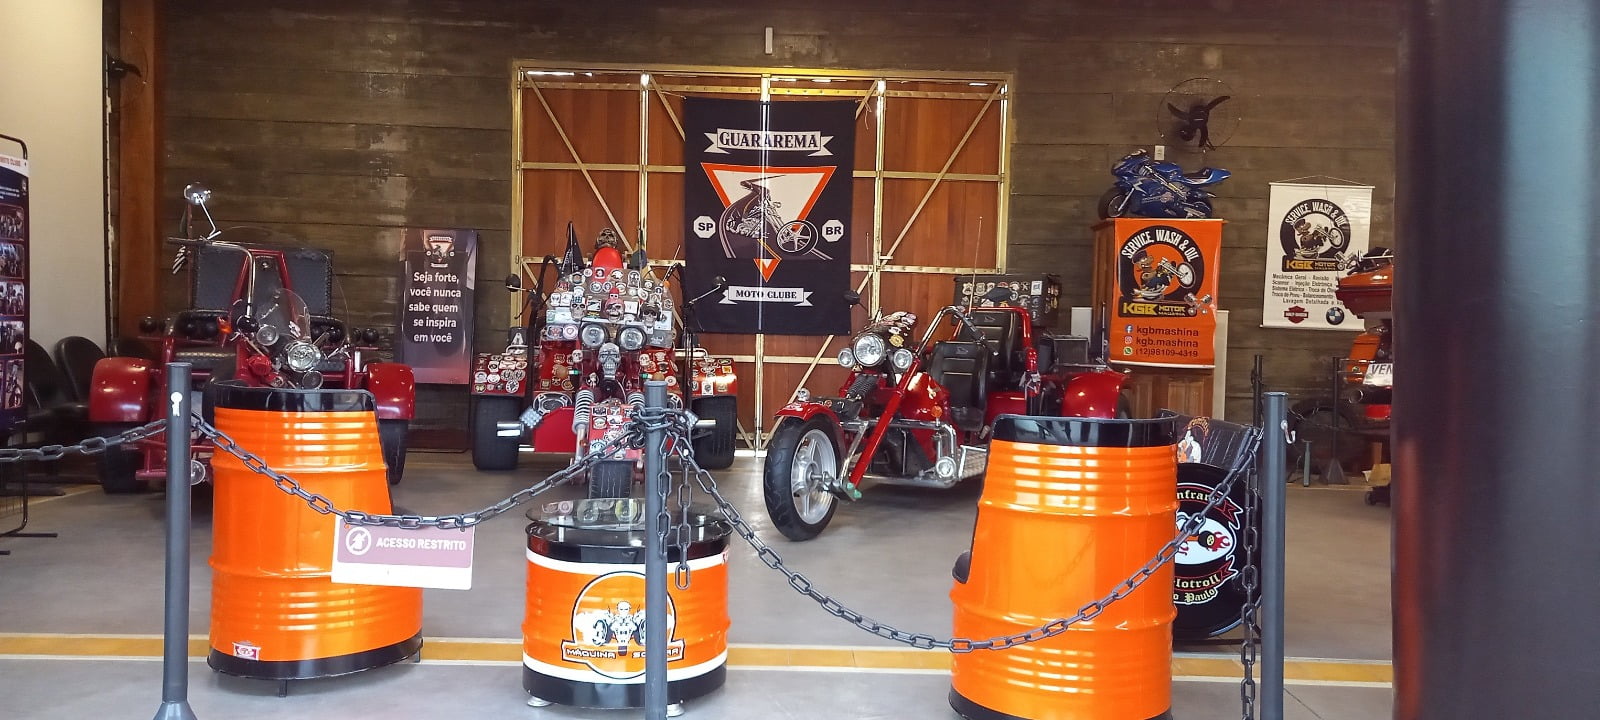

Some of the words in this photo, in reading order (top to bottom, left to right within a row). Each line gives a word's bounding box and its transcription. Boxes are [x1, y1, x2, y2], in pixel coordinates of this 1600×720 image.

[719, 131, 818, 149] GUARAREMA
[1312, 201, 1334, 216] WASH
[698, 222, 714, 232] SP
[825, 226, 842, 236] BR
[1155, 229, 1183, 247] WASH
[1178, 239, 1190, 252] &
[1184, 246, 1200, 263] OIL
[1286, 260, 1315, 270] KGB
[413, 271, 433, 284] Seja
[434, 272, 460, 285] forte,
[410, 287, 432, 297] você
[433, 288, 462, 298] nunca
[735, 289, 764, 298] MOTO
[767, 291, 797, 299] CLUBE
[408, 301, 430, 312] sabe
[432, 305, 459, 314] quem
[1122, 303, 1158, 315] KGB
[1158, 304, 1186, 312] MOTOR
[413, 318, 424, 327] se
[425, 317, 457, 329] inspira
[430, 332, 453, 343] você
[1136, 326, 1199, 337] kgbmashina
[1136, 336, 1199, 348] kgb.mashina
[376, 537, 416, 549] ACESSO
[417, 538, 467, 551] RESTRITO
[1184, 589, 1216, 603] Paulo
[566, 648, 617, 660] MÁQUINA
